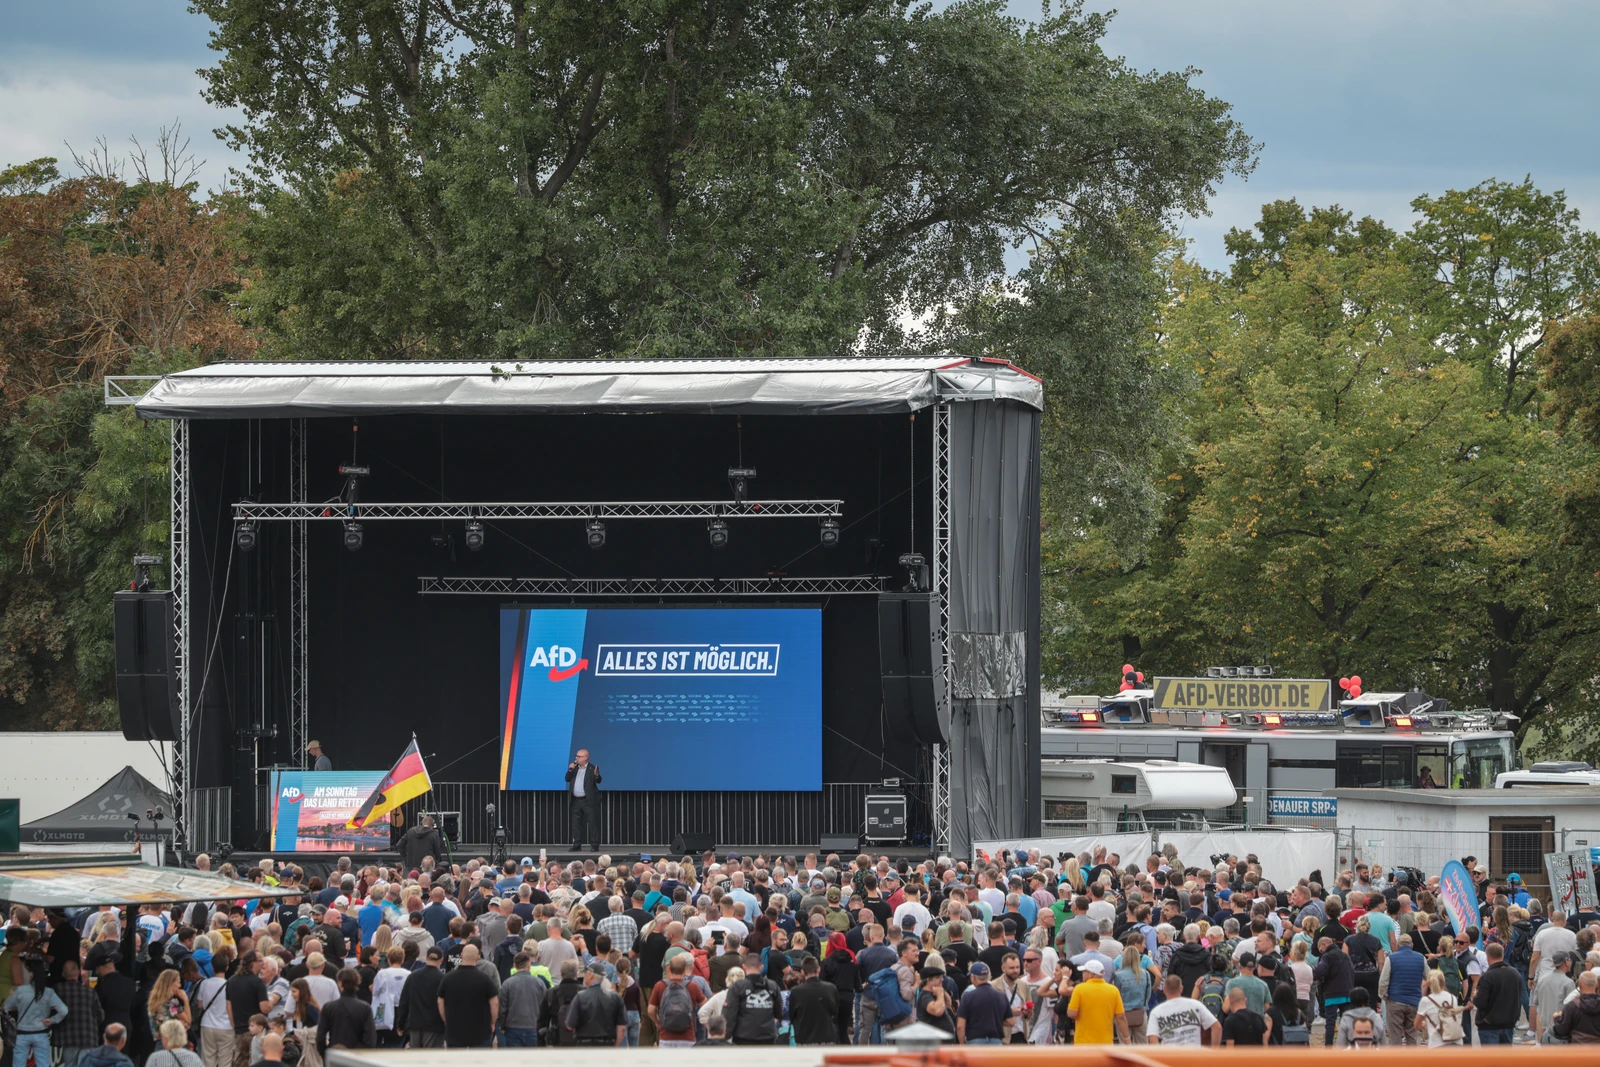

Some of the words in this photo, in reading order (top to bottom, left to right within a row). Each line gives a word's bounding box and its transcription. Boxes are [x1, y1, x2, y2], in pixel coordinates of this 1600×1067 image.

[530, 645, 576, 667] AfD
[603, 651, 657, 670] ALLES
[661, 651, 690, 670] IST
[694, 646, 773, 670] MÖGLICH.
[1174, 683, 1310, 707] AFD-VERBOT.DE
[282, 787, 300, 797] AfD
[314, 787, 325, 797] AM
[326, 787, 358, 797] SONNTAG
[304, 798, 318, 808] DAS
[318, 798, 336, 808] LAND
